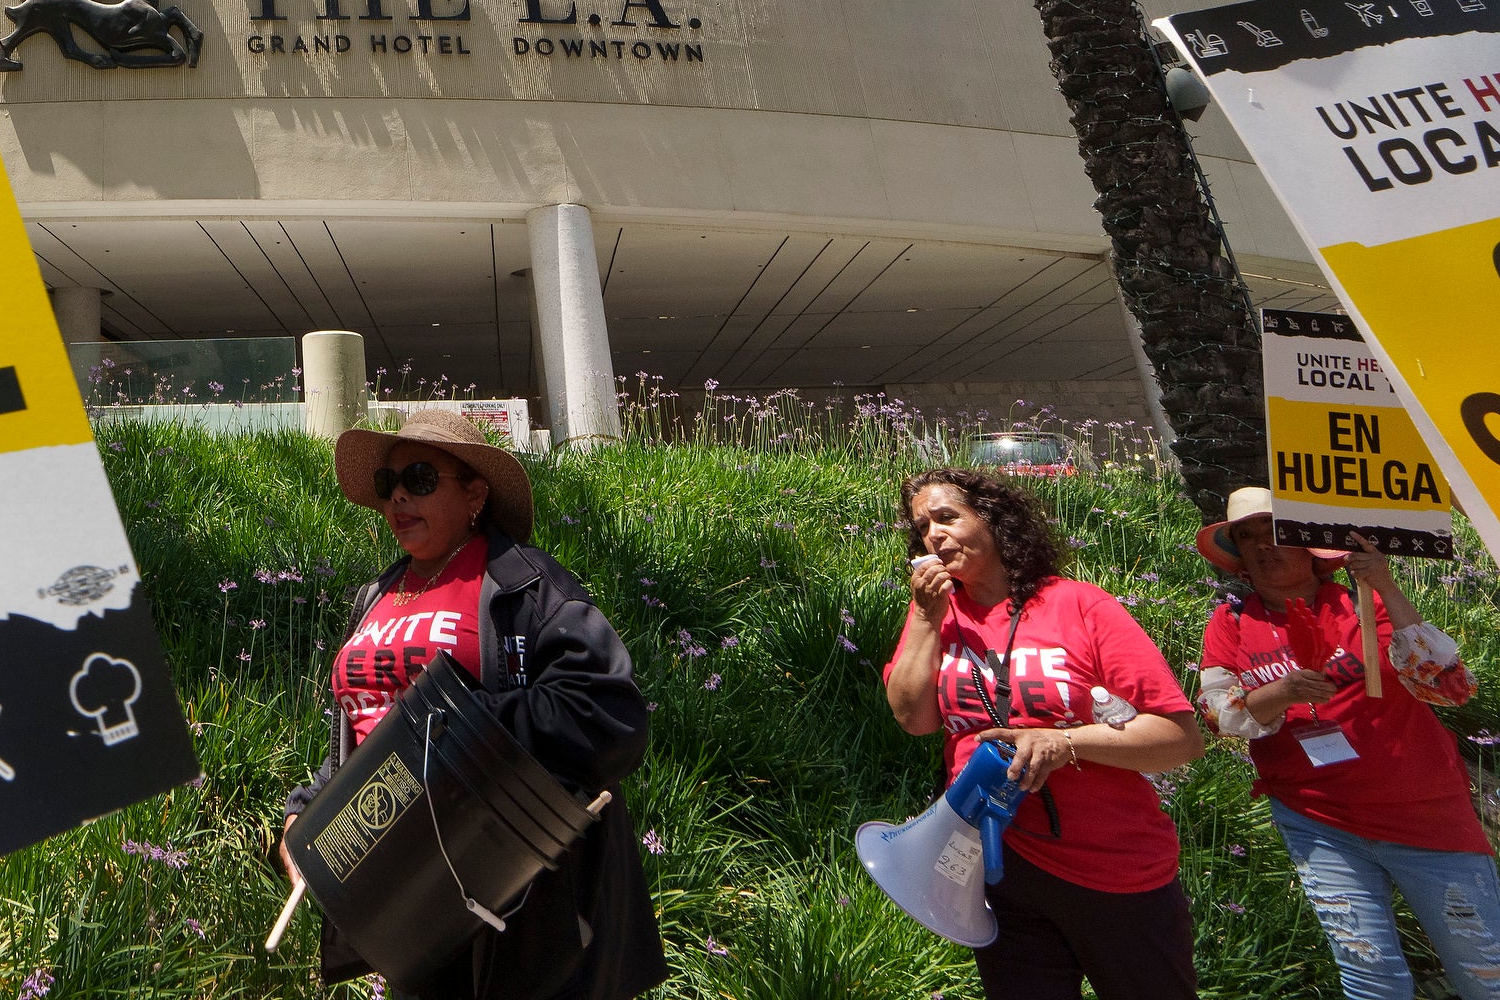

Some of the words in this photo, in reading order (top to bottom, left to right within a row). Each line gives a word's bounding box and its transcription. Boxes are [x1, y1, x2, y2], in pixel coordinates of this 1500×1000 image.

[247, 33, 352, 56] GRAND
[370, 34, 472, 55] HOTEL
[512, 36, 705, 63] DOWNTOWN
[1315, 82, 1466, 140] UNITE
[1342, 120, 1500, 193] LOCA
[1297, 352, 1352, 371] UNITE
[1298, 368, 1376, 392] LOCAL
[1328, 410, 1381, 455] EN
[1276, 450, 1443, 505] HUELGA
[392, 772, 412, 794] AVISO
[393, 760, 420, 795] WARNING
[938, 854, 967, 876] 263
